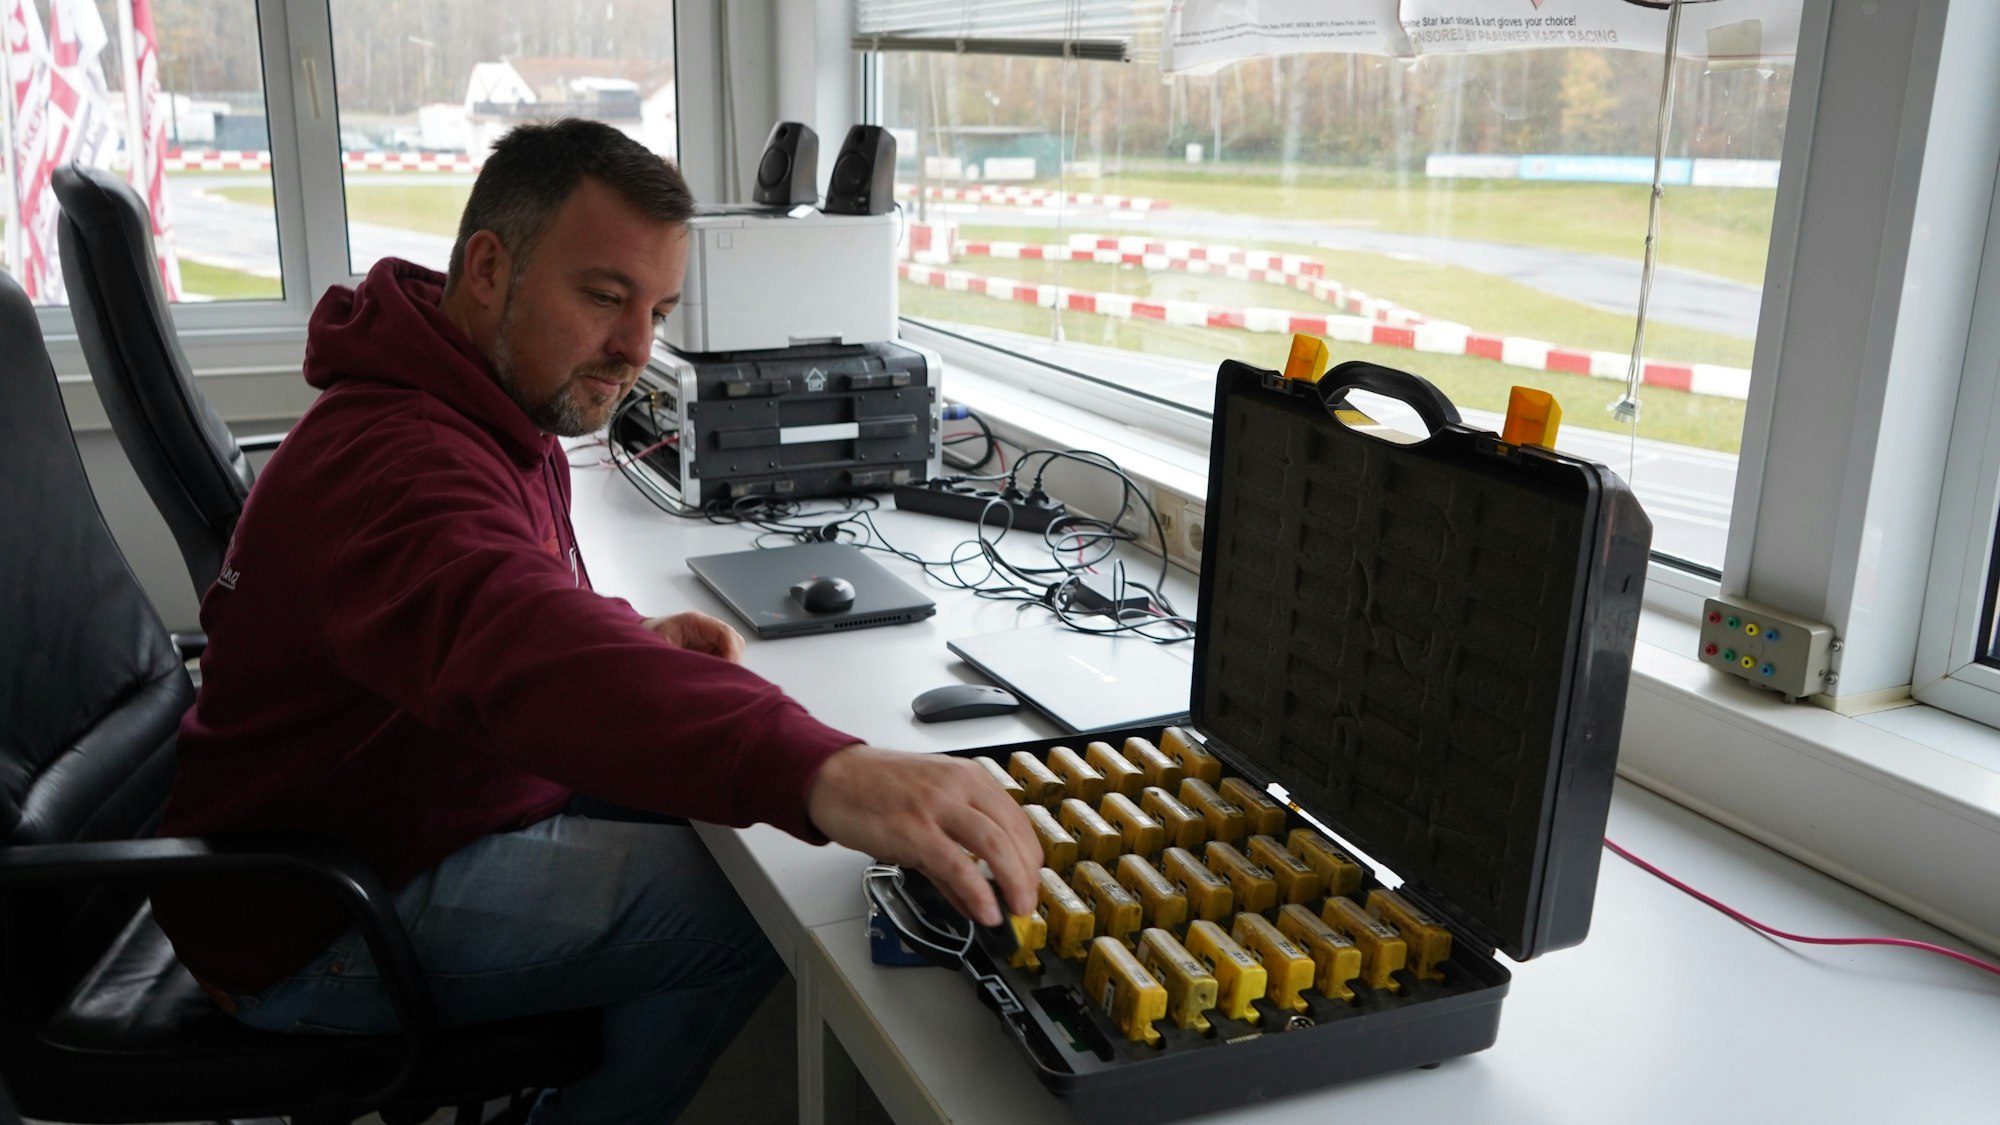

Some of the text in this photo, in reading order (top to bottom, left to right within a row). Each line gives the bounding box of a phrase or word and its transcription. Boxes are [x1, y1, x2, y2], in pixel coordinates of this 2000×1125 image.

[1422, 17, 1438, 27] Star
[1440, 15, 1455, 25] kart
[1456, 15, 1475, 26] shoes
[1482, 16, 1497, 26] kart
[1497, 16, 1522, 29] gloves
[1524, 17, 1543, 29] your
[1545, 15, 1576, 26] choice!
[1464, 29, 1477, 41] BY
[1534, 31, 1564, 42] KART
[1568, 29, 1618, 43] RACING
